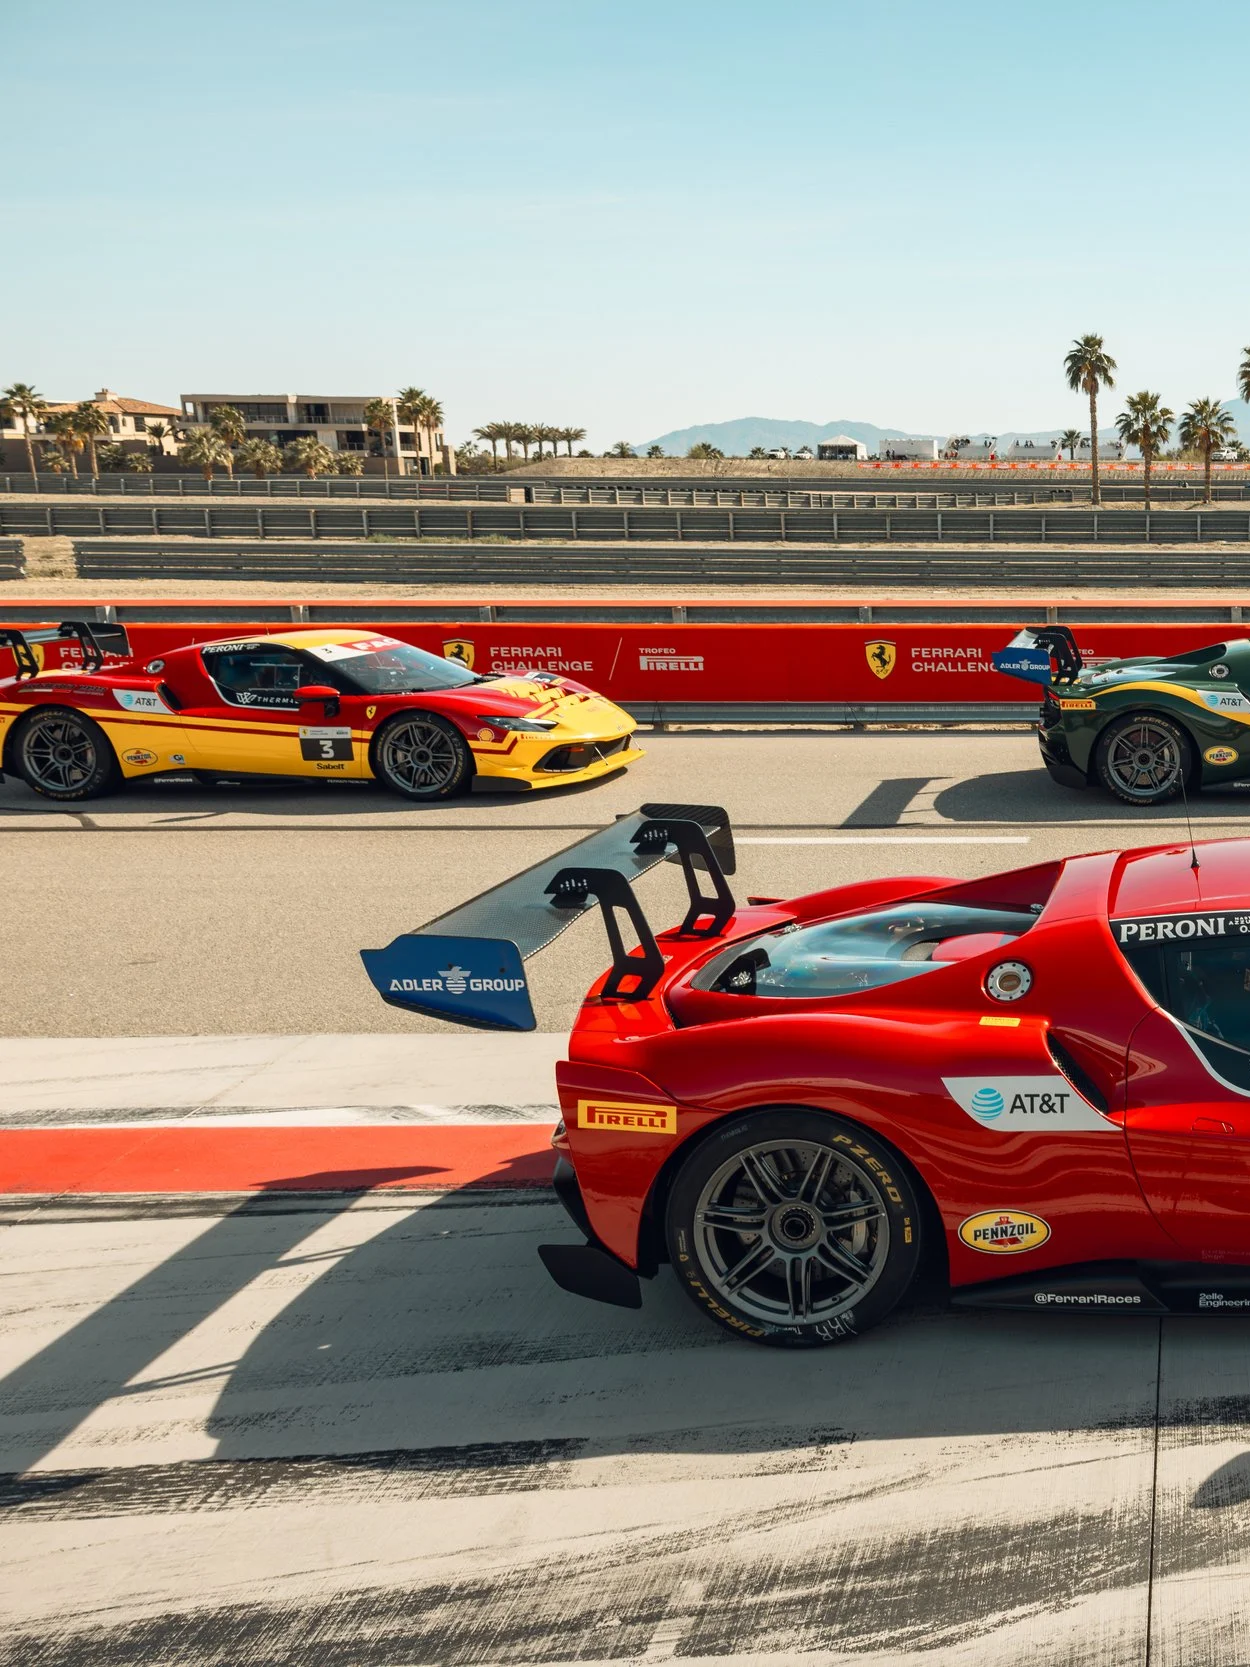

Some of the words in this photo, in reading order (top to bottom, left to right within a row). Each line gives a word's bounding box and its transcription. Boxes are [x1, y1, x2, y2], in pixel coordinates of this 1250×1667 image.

[201, 643, 244, 654] PERONI
[490, 646, 562, 657] FERRARI
[911, 648, 982, 658] FERRARI
[491, 660, 594, 671] CHALLENGE
[638, 656, 705, 671] PIRELLI
[911, 661, 1000, 673] CHALLEN
[1029, 663, 1051, 671] GROUP
[134, 699, 157, 707] AT&T
[1219, 698, 1243, 707] AT&T
[319, 740, 335, 759] 3
[1209, 751, 1233, 760] PENNZOIL
[1120, 917, 1226, 943] PERONI
[389, 979, 444, 991] ADLER
[469, 978, 525, 992] GROUP
[1009, 1093, 1070, 1114] AT&T
[586, 1105, 668, 1129] PIRELLI
[973, 1222, 1037, 1241] PENNZOIL
[1034, 1293, 1141, 1305] @FerrariRaces
[690, 1281, 765, 1337] PIRELLI
